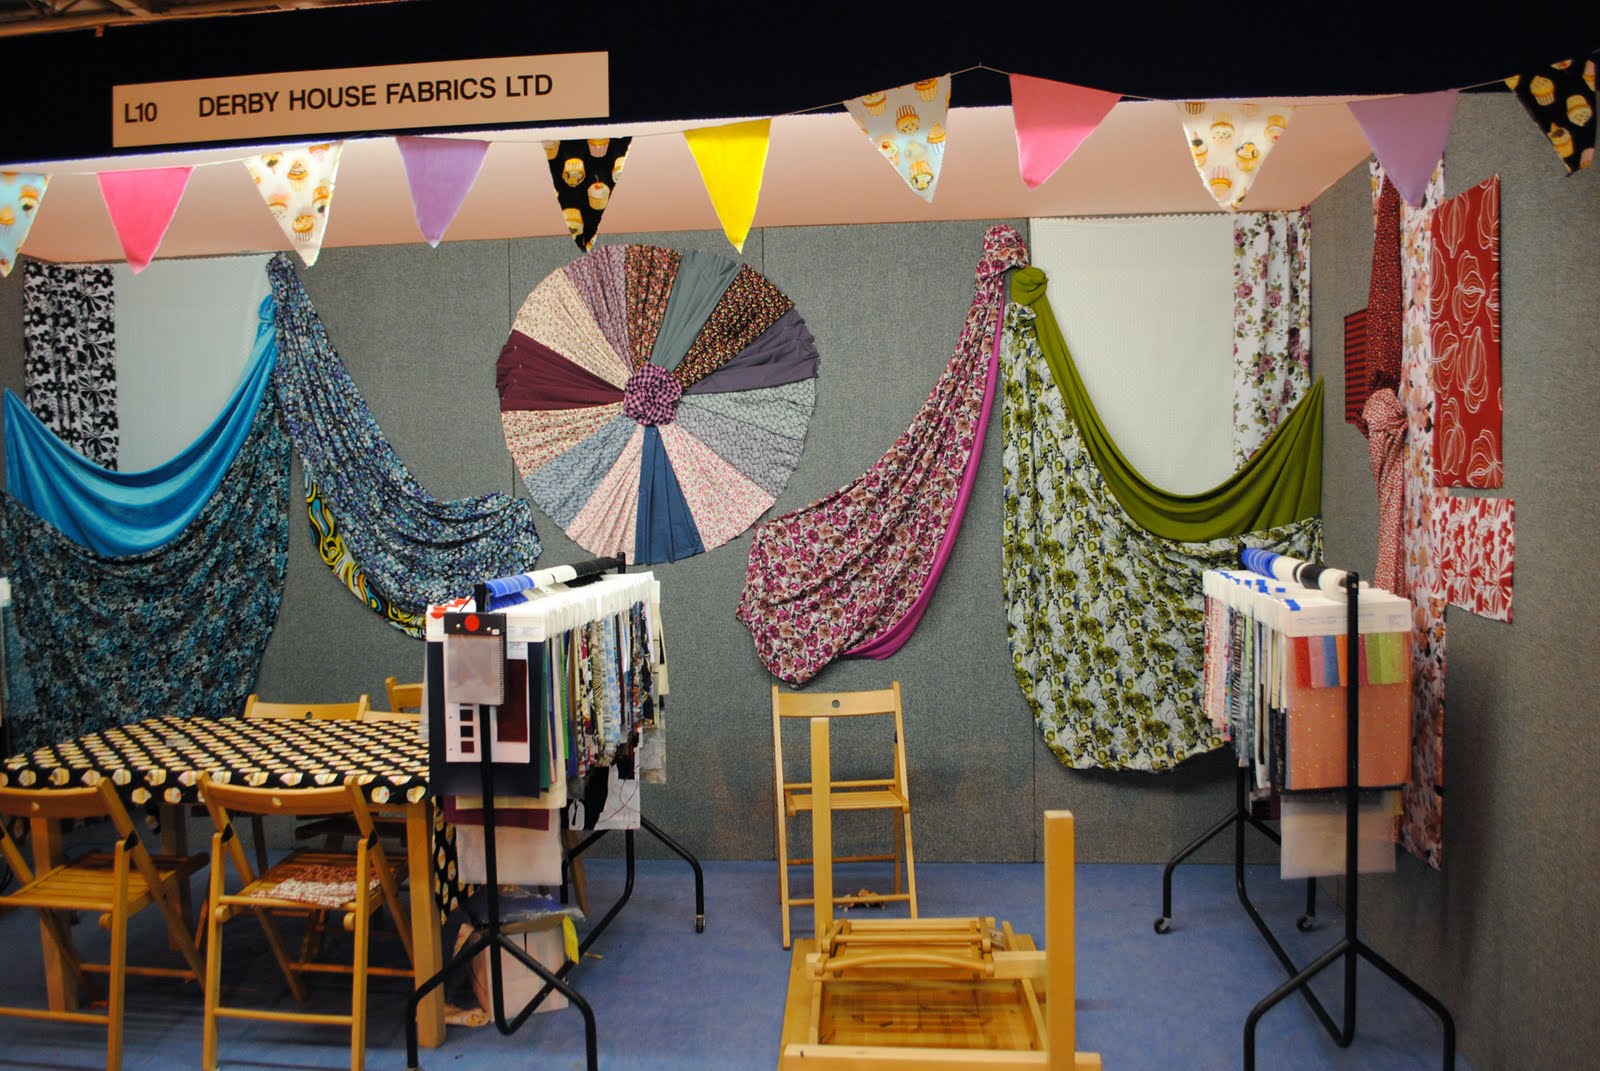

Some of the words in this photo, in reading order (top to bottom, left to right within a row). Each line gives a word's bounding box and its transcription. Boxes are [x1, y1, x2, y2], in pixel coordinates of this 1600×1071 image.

[124, 101, 158, 124] L10
[198, 91, 280, 118] DERBY
[289, 84, 377, 111] HOUSE
[386, 76, 497, 105] FABRICS
[506, 73, 553, 98] LTD
